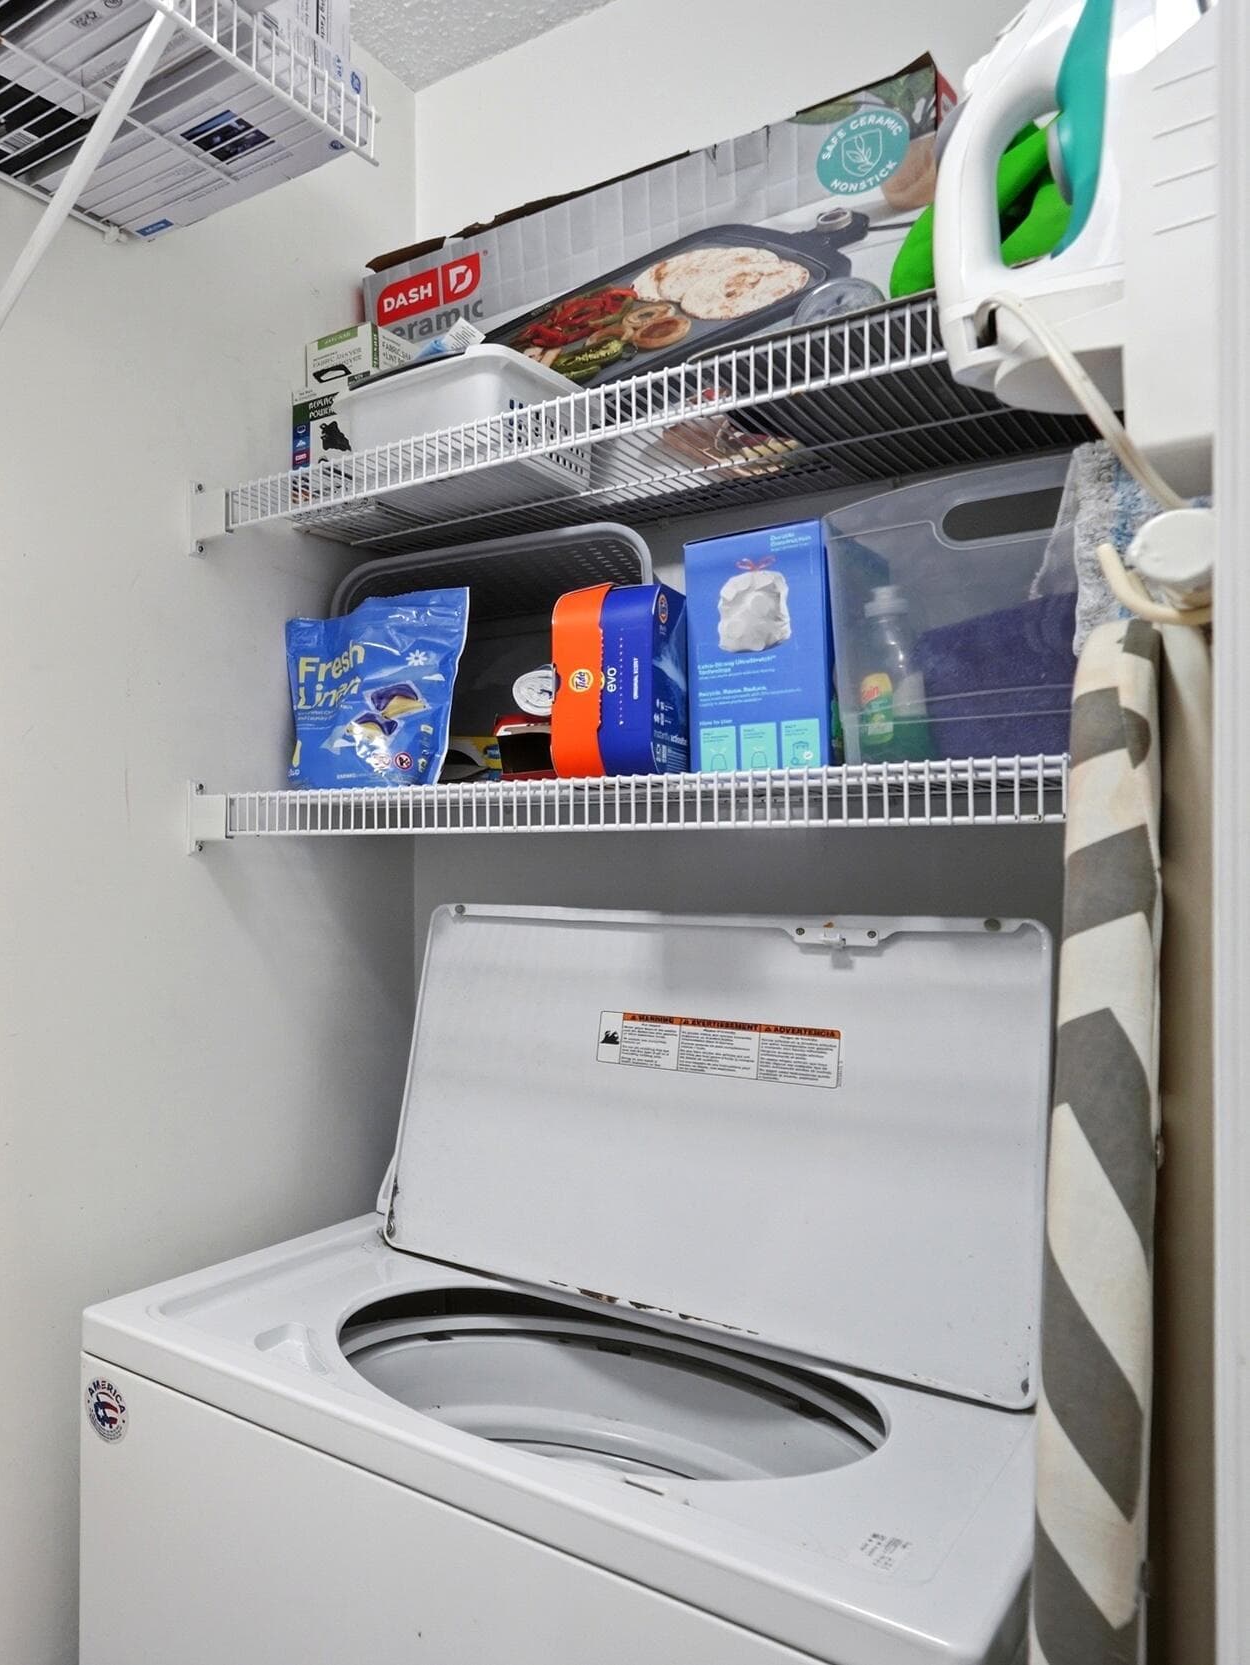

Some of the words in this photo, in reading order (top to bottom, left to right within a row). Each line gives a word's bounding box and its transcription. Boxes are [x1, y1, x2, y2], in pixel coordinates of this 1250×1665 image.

[822, 129, 846, 160] SAFE
[850, 114, 903, 137] CERAMIC
[830, 160, 898, 192] NONSTICK
[383, 282, 432, 313] DASH
[391, 299, 484, 340] eramic
[299, 641, 365, 682] Fresh
[297, 677, 362, 710] Linen
[575, 671, 589, 690] Tide
[606, 667, 617, 693] evo
[639, 1015, 674, 1025] WARNING
[773, 1026, 835, 1038] ADVERTENCIA
[87, 1380, 126, 1414] AMERICA
